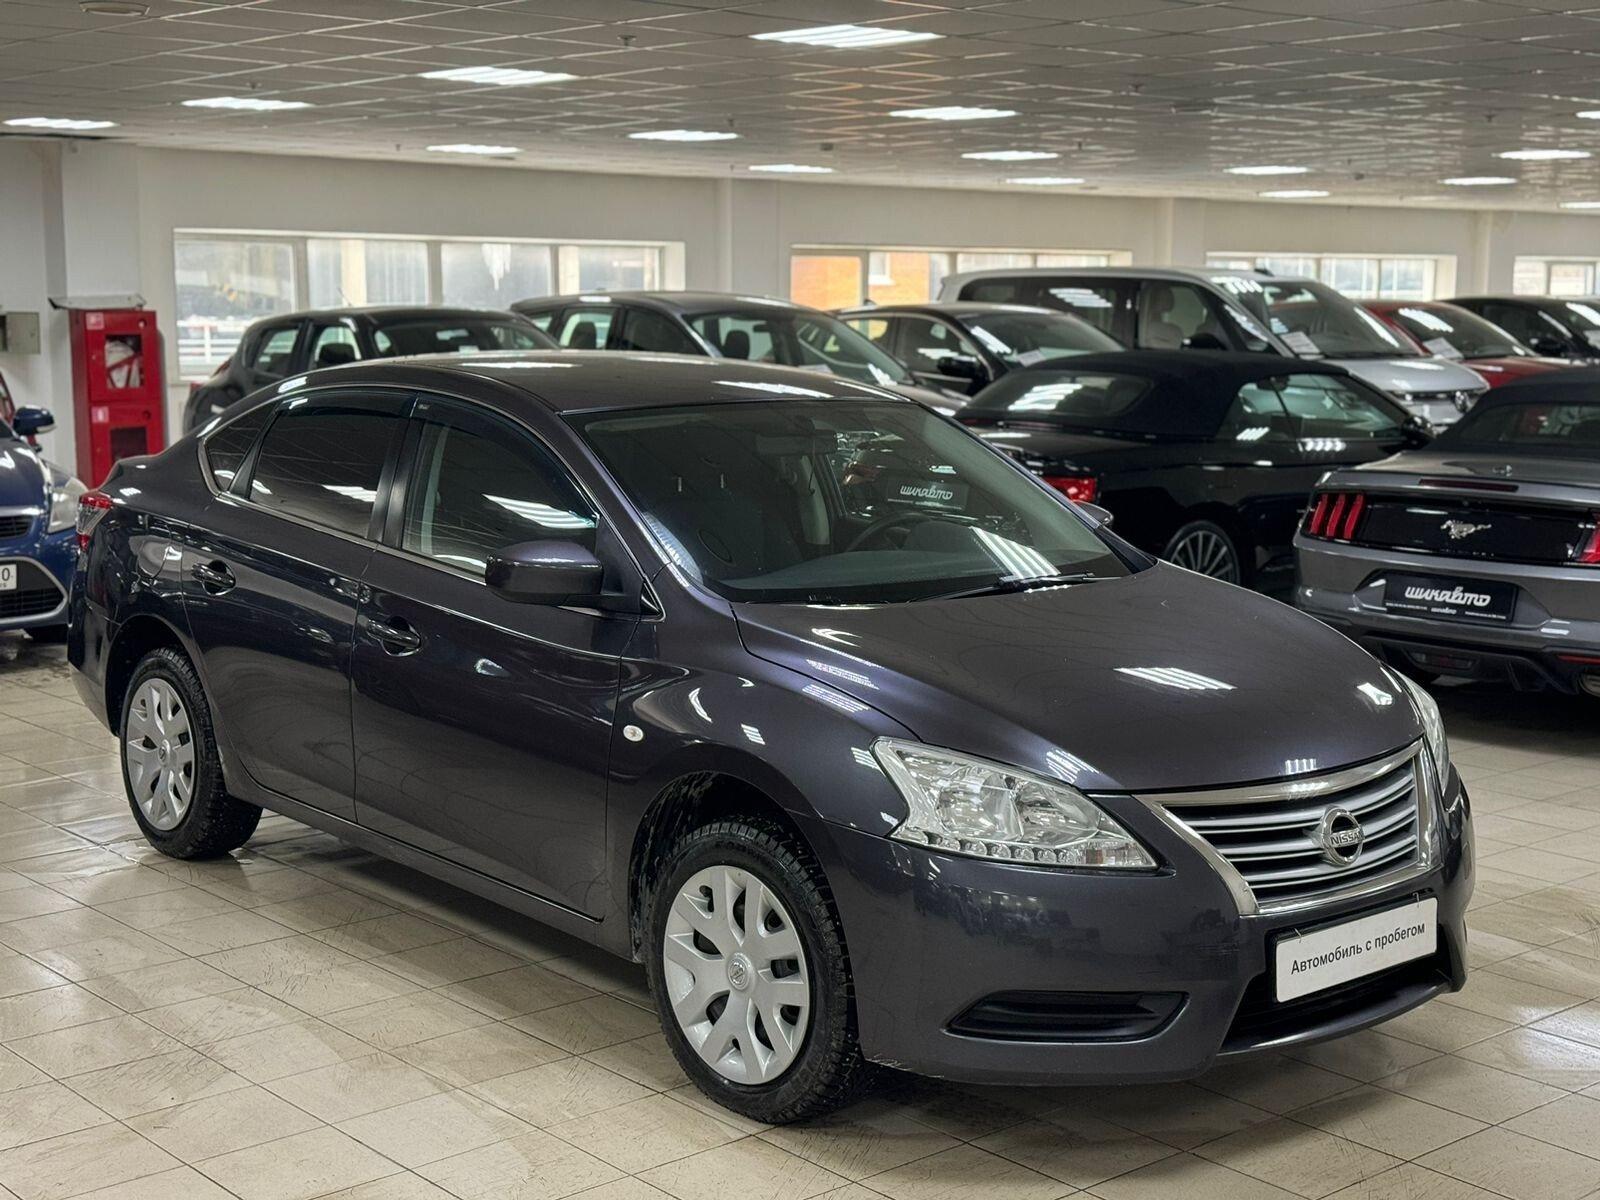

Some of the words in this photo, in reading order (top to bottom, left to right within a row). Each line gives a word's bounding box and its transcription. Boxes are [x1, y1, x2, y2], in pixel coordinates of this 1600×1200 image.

[1291, 943, 1363, 975] Автомобиль
[1365, 941, 1372, 951] с
[1374, 922, 1425, 950] пробегом
